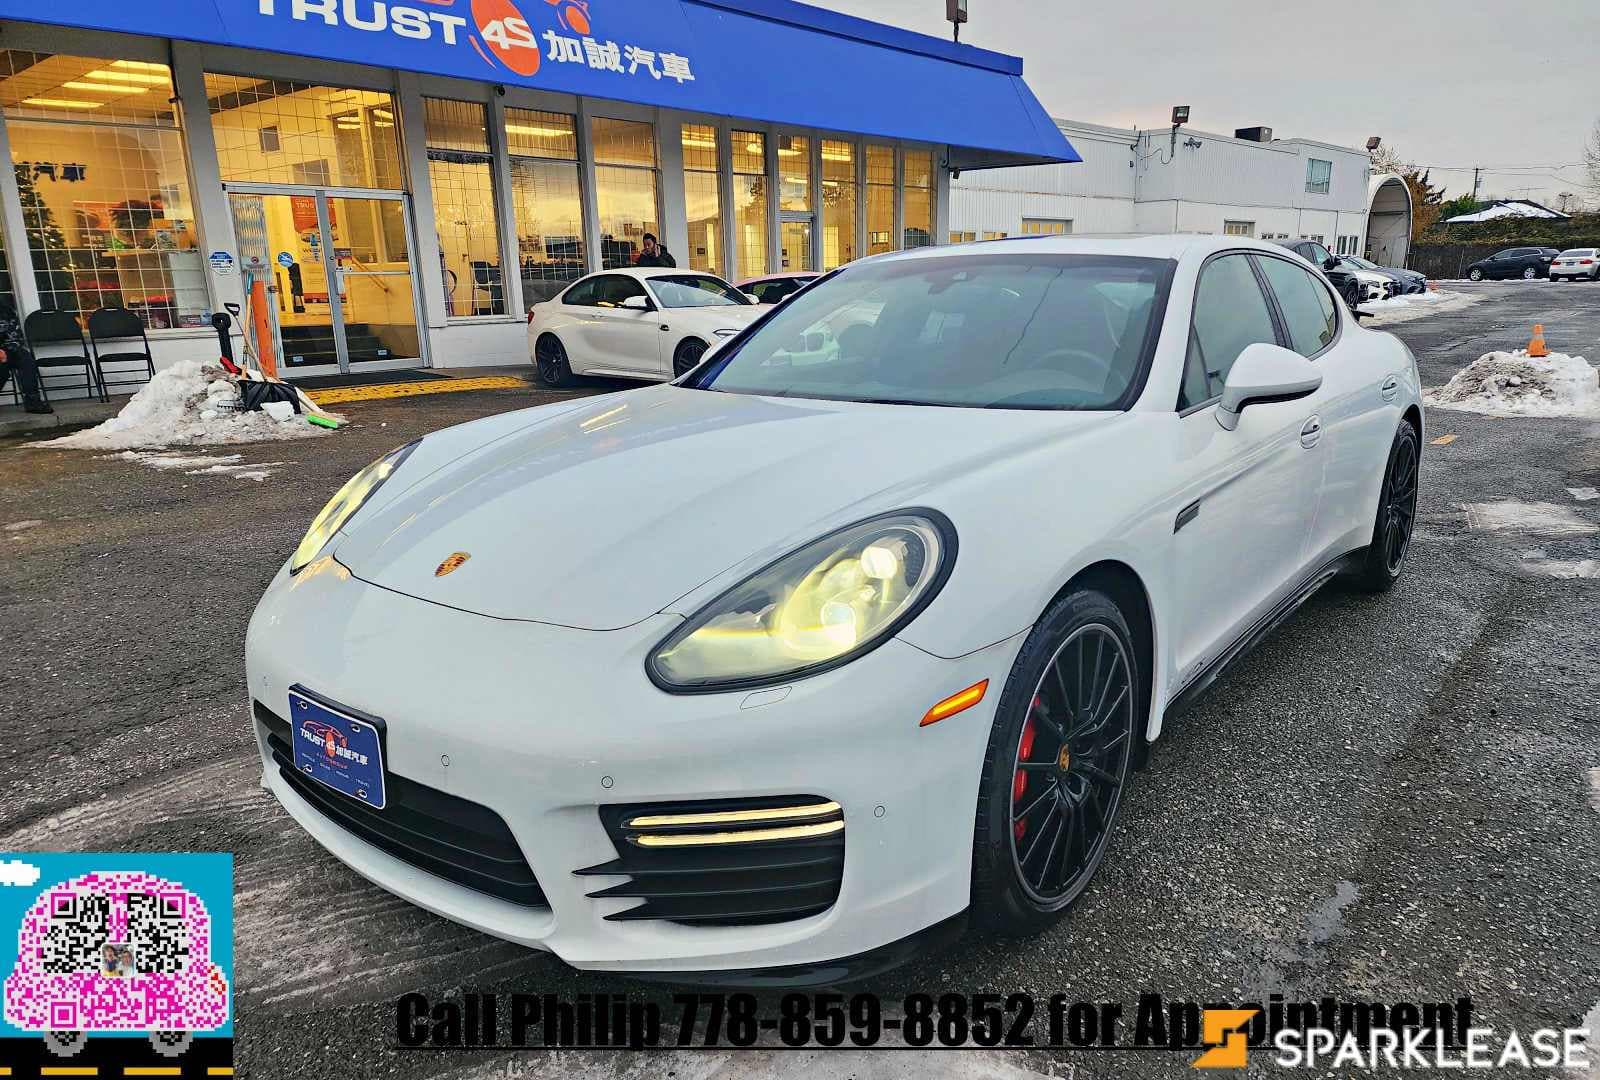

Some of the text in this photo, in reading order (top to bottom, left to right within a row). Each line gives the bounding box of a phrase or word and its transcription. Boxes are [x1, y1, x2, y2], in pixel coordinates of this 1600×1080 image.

[480, 16, 538, 49] 4S
[542, 30, 696, 83] 加誠汽車
[299, 727, 326, 747] TRUST
